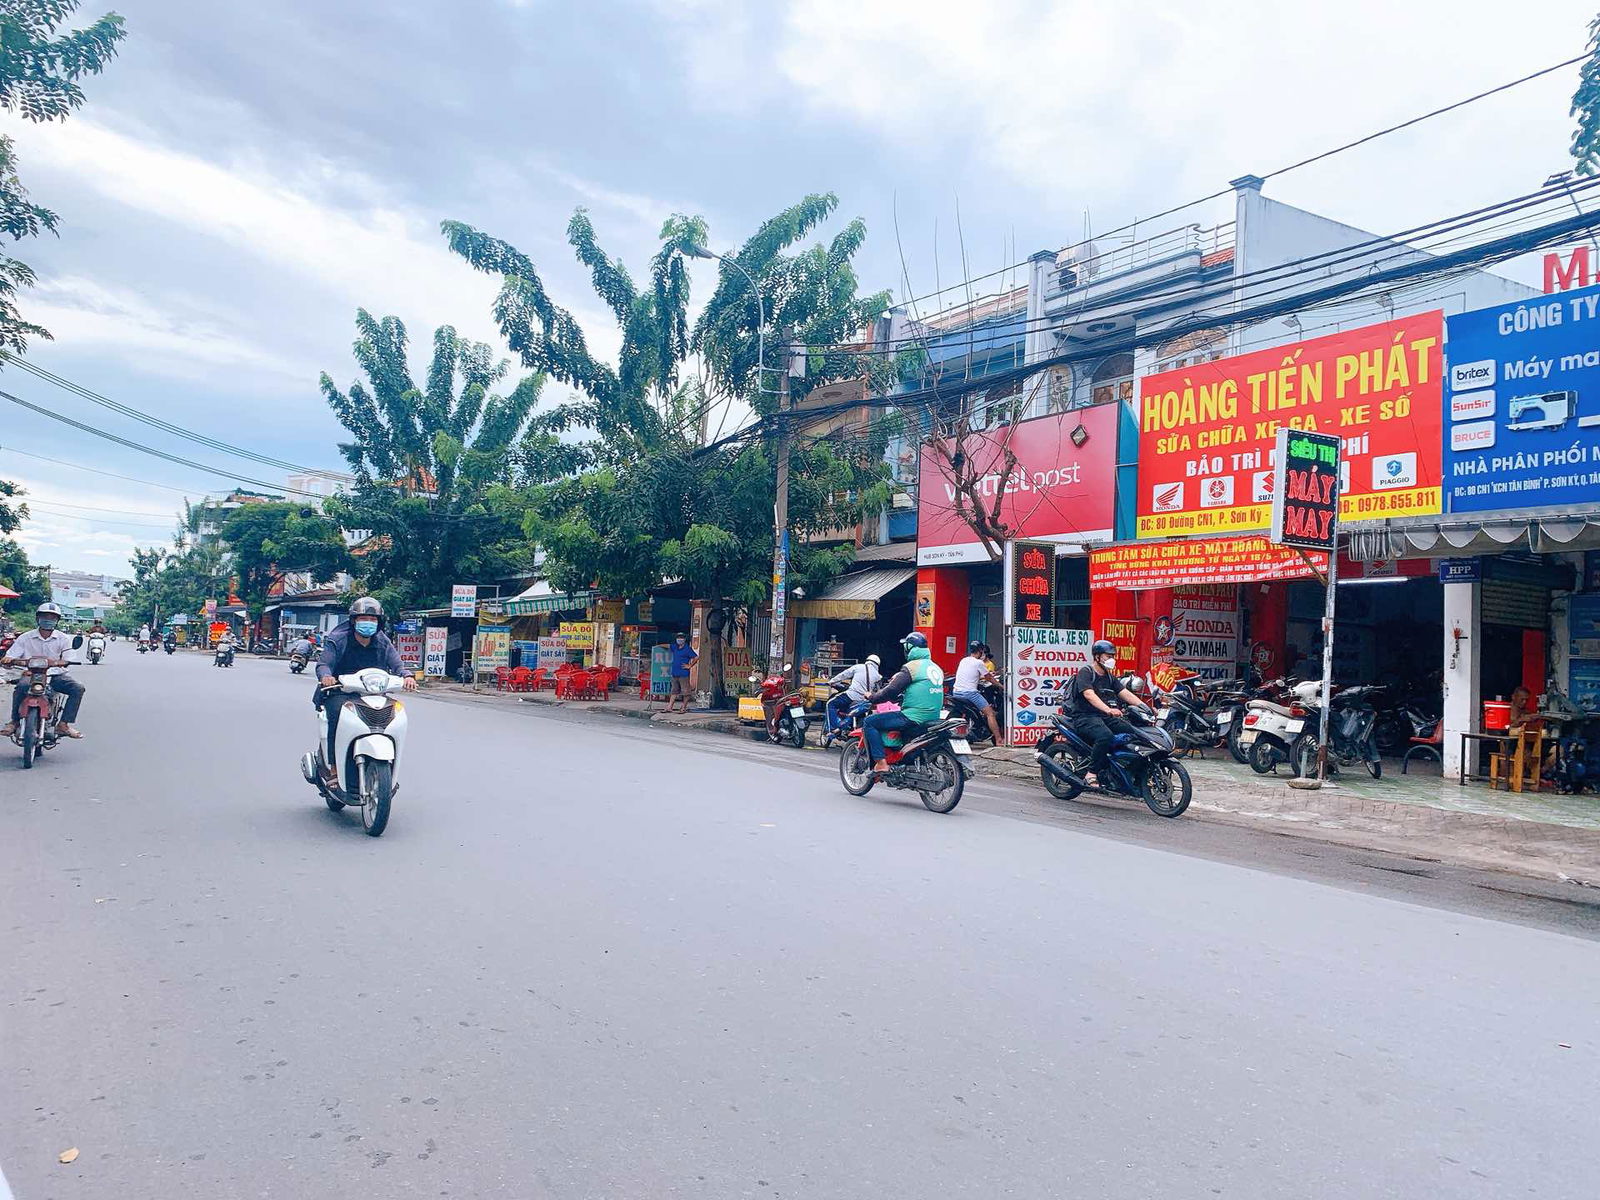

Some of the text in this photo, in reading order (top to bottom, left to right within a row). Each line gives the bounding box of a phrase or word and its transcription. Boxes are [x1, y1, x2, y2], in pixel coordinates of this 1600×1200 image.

[1498, 294, 1599, 336] CÔNG TY
[1456, 367, 1490, 381] britex
[1504, 355, 1553, 380] Máy
[1143, 331, 1437, 433] HOÀNG TIẾN PHÁT
[1453, 400, 1491, 411] SunSir
[1156, 427, 1191, 455] SỬA
[1197, 424, 1247, 443] CHỮA
[1255, 419, 1281, 439] XE
[1289, 414, 1317, 432] GA
[1340, 404, 1370, 427] XE
[1380, 391, 1413, 421] SỐ
[1454, 430, 1491, 442] BRUCE
[1290, 438, 1317, 460] SIÊU
[1318, 444, 1336, 467] THỊ
[1454, 456, 1488, 476] NHÀ
[1492, 452, 1538, 472] PHÂN
[1544, 440, 1587, 466] PHỐI
[1186, 453, 1223, 477] BẢO
[1231, 451, 1261, 470] TRÌ
[1033, 461, 1081, 494] post
[1288, 465, 1335, 505] MÁY
[1380, 476, 1409, 486] PIAGGIO
[1544, 478, 1550, 488] P.
[1551, 476, 1567, 487] SƠN
[1580, 475, 1588, 485] Q.
[1156, 519, 1166, 530] 80
[1197, 512, 1216, 527] CN1,
[1219, 512, 1228, 524] P.
[1231, 510, 1247, 523] Sơn
[1358, 490, 1436, 513] 0978.655.811
[1286, 506, 1333, 540] MAY
[1023, 547, 1046, 570] SỬA
[1091, 552, 1116, 563] TRUNG
[1189, 544, 1202, 556] XE
[1448, 565, 1471, 574] HPP
[1026, 603, 1041, 620] XE
[1106, 623, 1124, 641] DỊCH
[1185, 620, 1233, 634] HONDA
[1036, 629, 1046, 644] XE
[1048, 630, 1059, 645] GA
[1066, 630, 1077, 645] XE
[1034, 651, 1087, 662] HONDA
[1188, 641, 1227, 657] YAMAHA
[1034, 666, 1078, 676] YAMAH
[1040, 679, 1068, 690] SY
